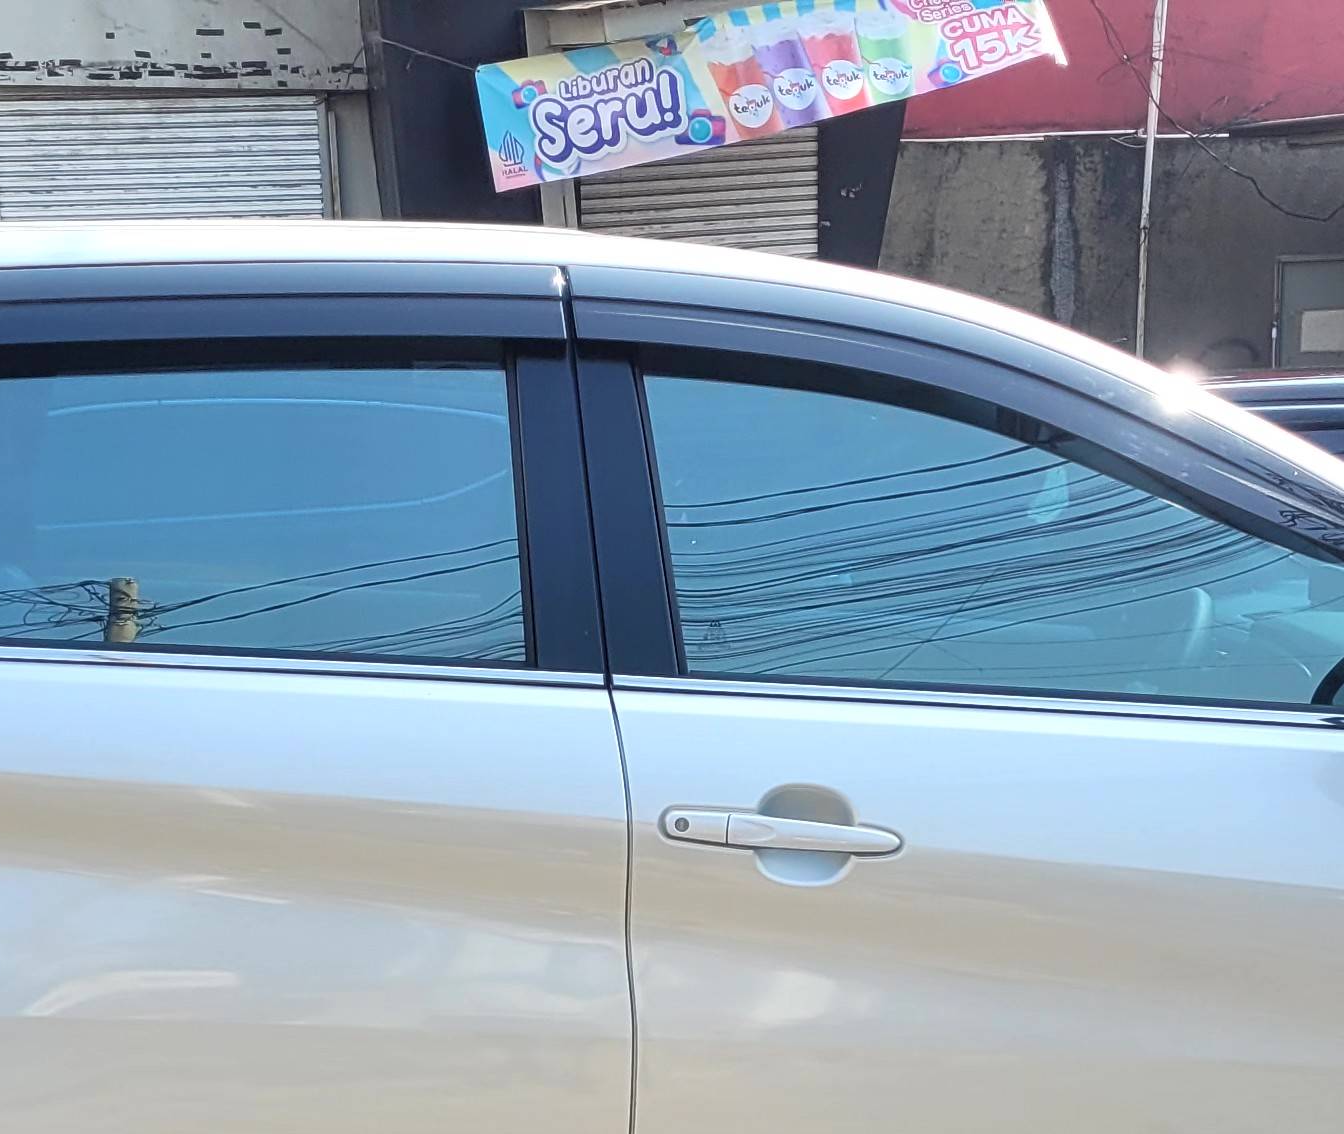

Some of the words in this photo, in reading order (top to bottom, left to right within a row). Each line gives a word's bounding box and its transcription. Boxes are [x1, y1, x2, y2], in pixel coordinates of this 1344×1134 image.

[920, 2, 972, 22] Series
[942, 7, 1024, 38] CUMA
[950, 24, 1042, 71] 15K
[558, 57, 654, 101] Liburan
[532, 69, 682, 164] Seru!
